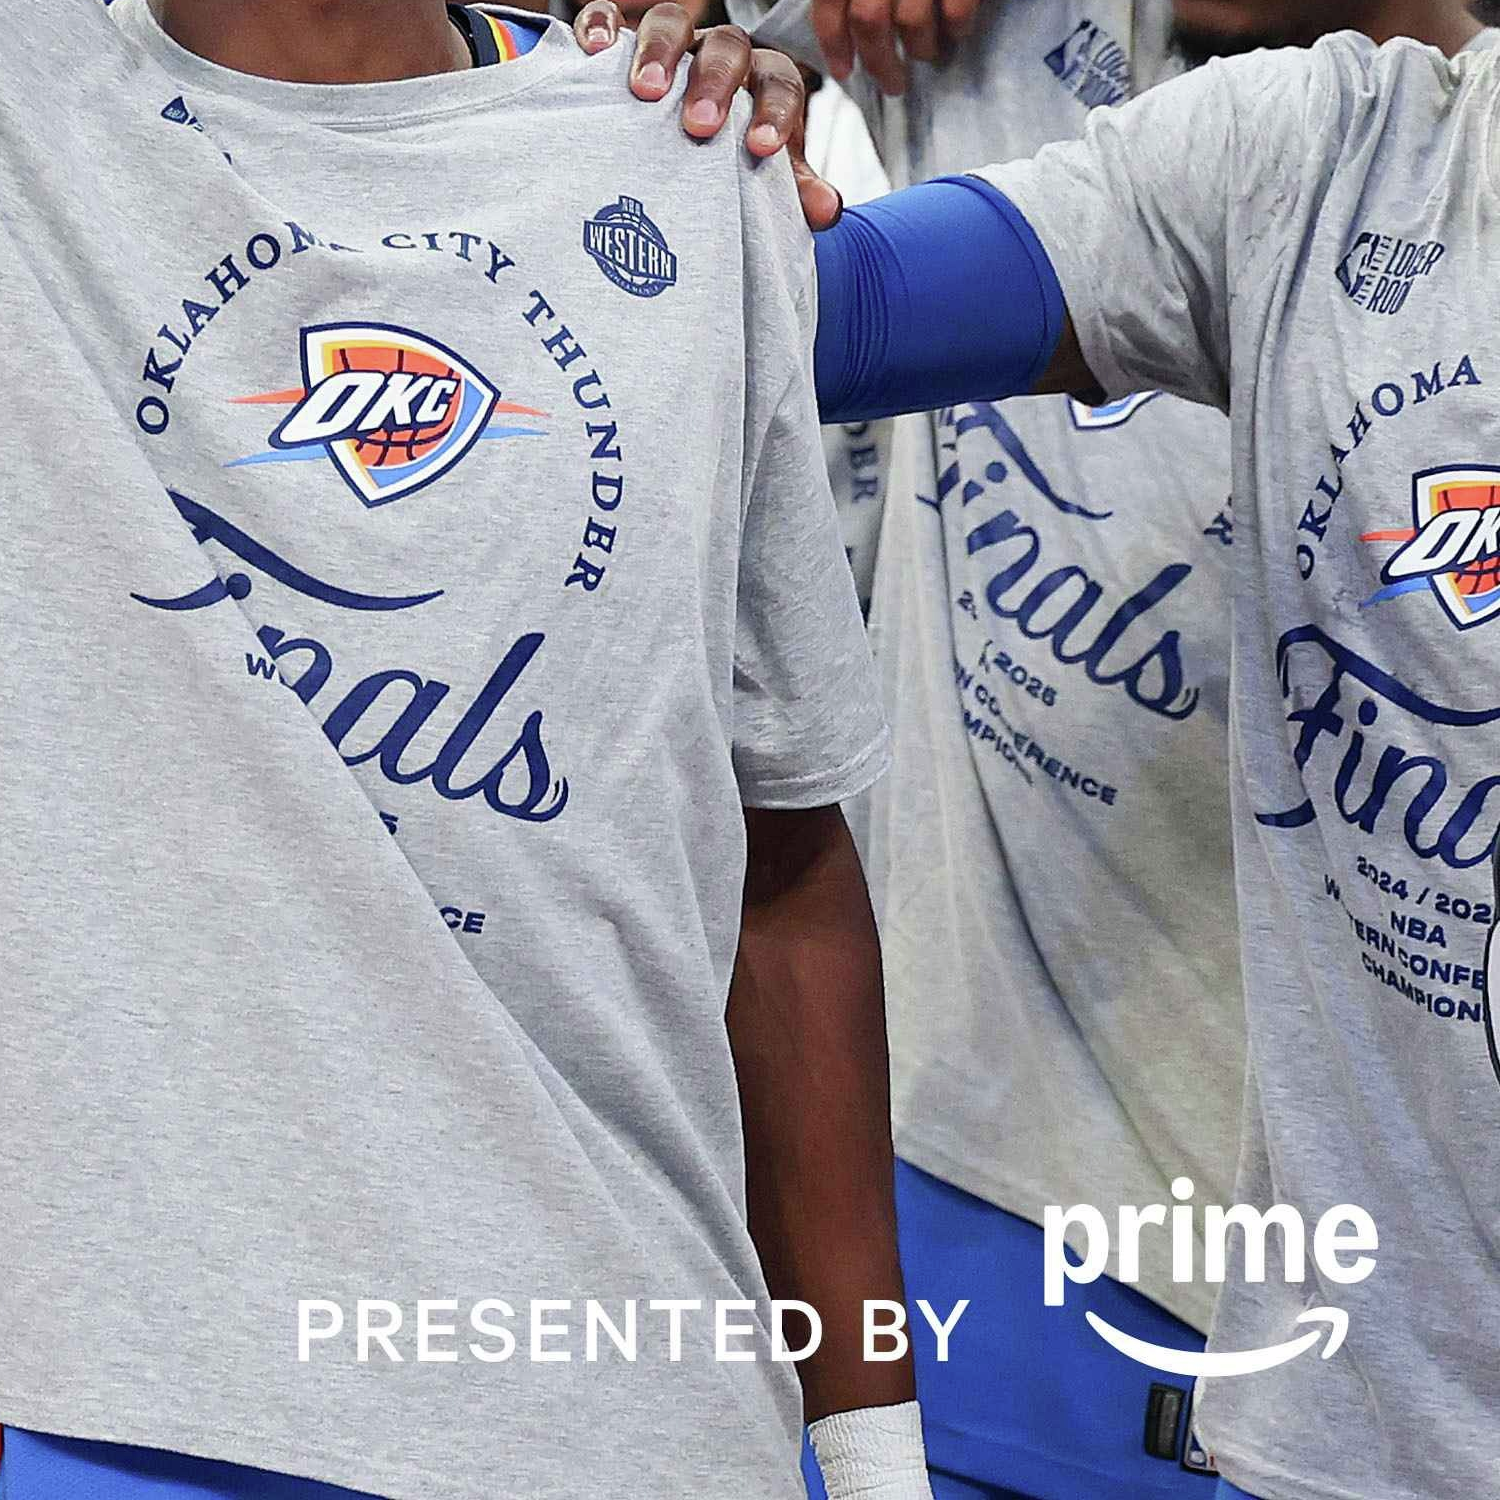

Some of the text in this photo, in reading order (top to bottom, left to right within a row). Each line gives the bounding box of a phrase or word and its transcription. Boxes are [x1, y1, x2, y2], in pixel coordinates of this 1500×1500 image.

[588, 223, 672, 280] WESTERN
[276, 368, 461, 446] OKC
[380, 231, 516, 285] CITY
[521, 289, 624, 593] THUNDER
[1296, 354, 1482, 582] OKLAHOMA
[1390, 910, 1447, 949] NBA
[1434, 892, 1492, 925] 202
[1361, 951, 1485, 1023] CHAMPION
